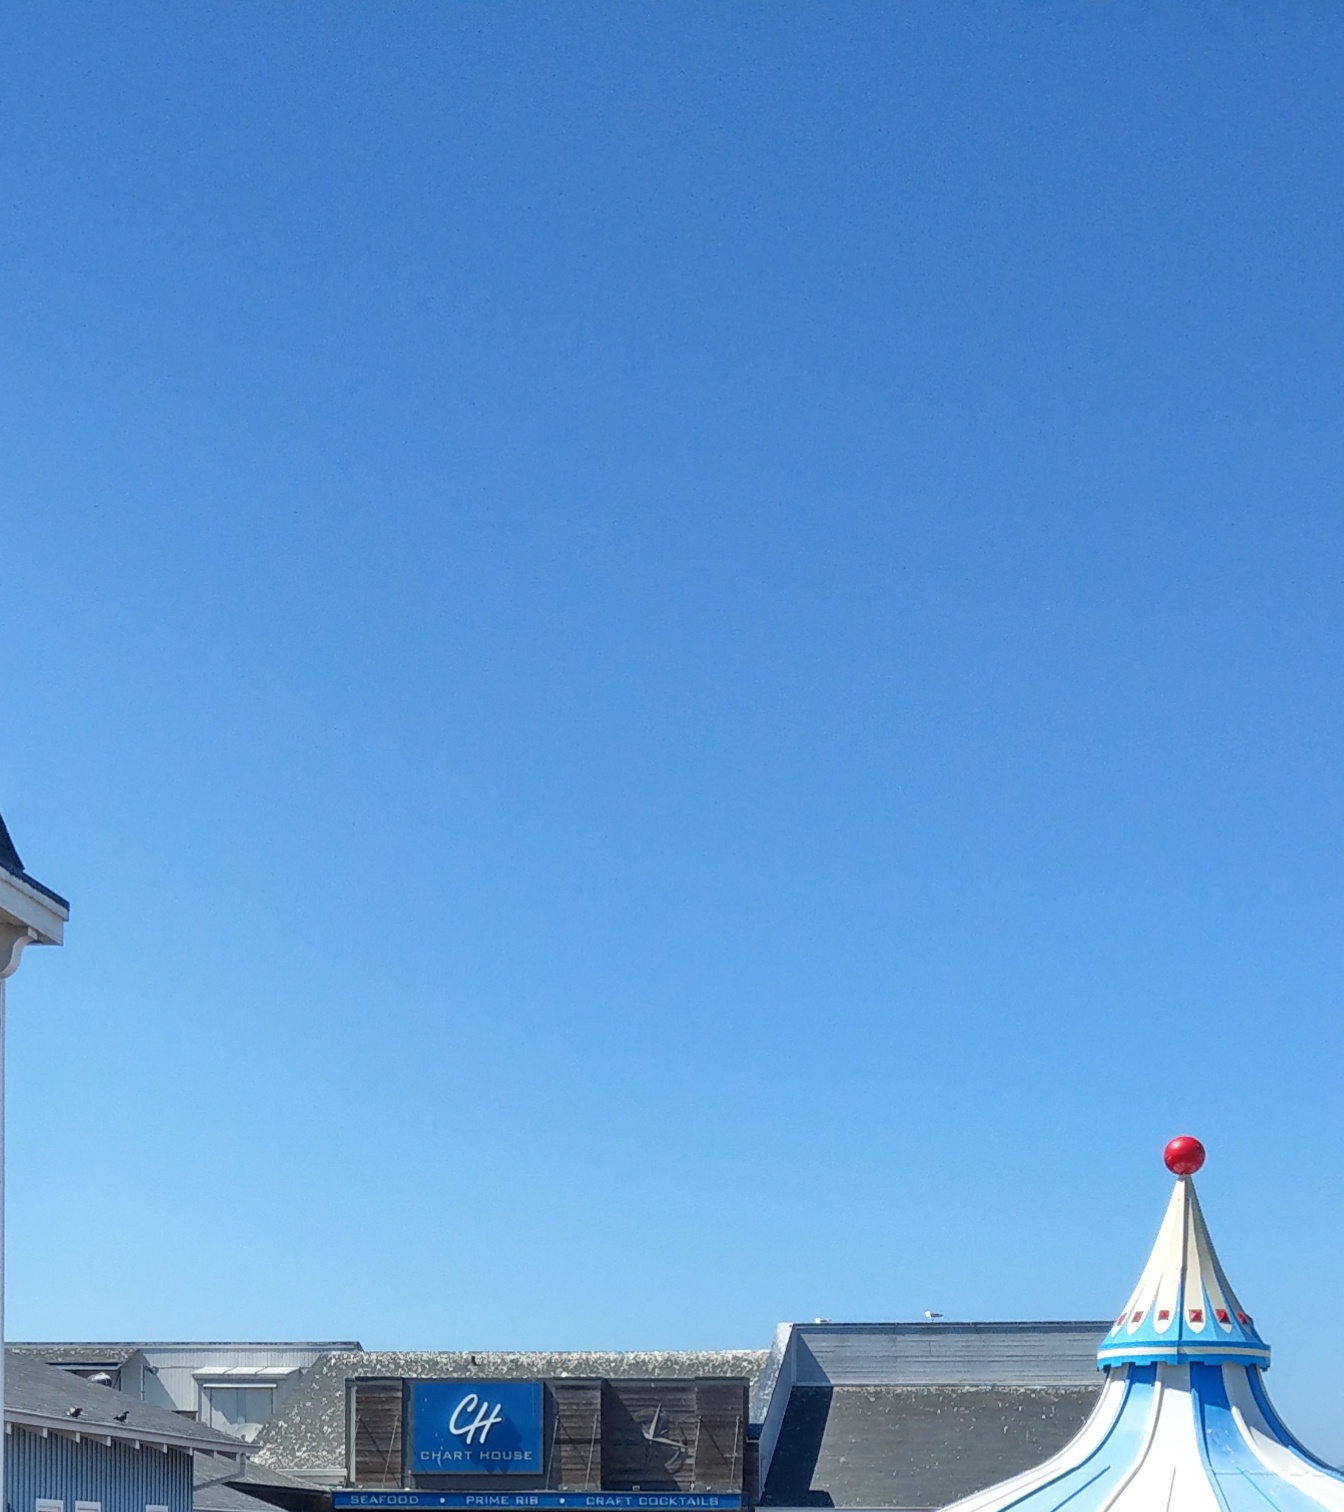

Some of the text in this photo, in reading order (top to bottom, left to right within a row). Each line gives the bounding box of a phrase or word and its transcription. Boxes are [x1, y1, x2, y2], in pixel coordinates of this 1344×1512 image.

[420, 1451, 533, 1461] CHART HOUSE
[350, 1495, 720, 1507] SEAFOOD PRIME RIB CRAFT COCKTAILS
